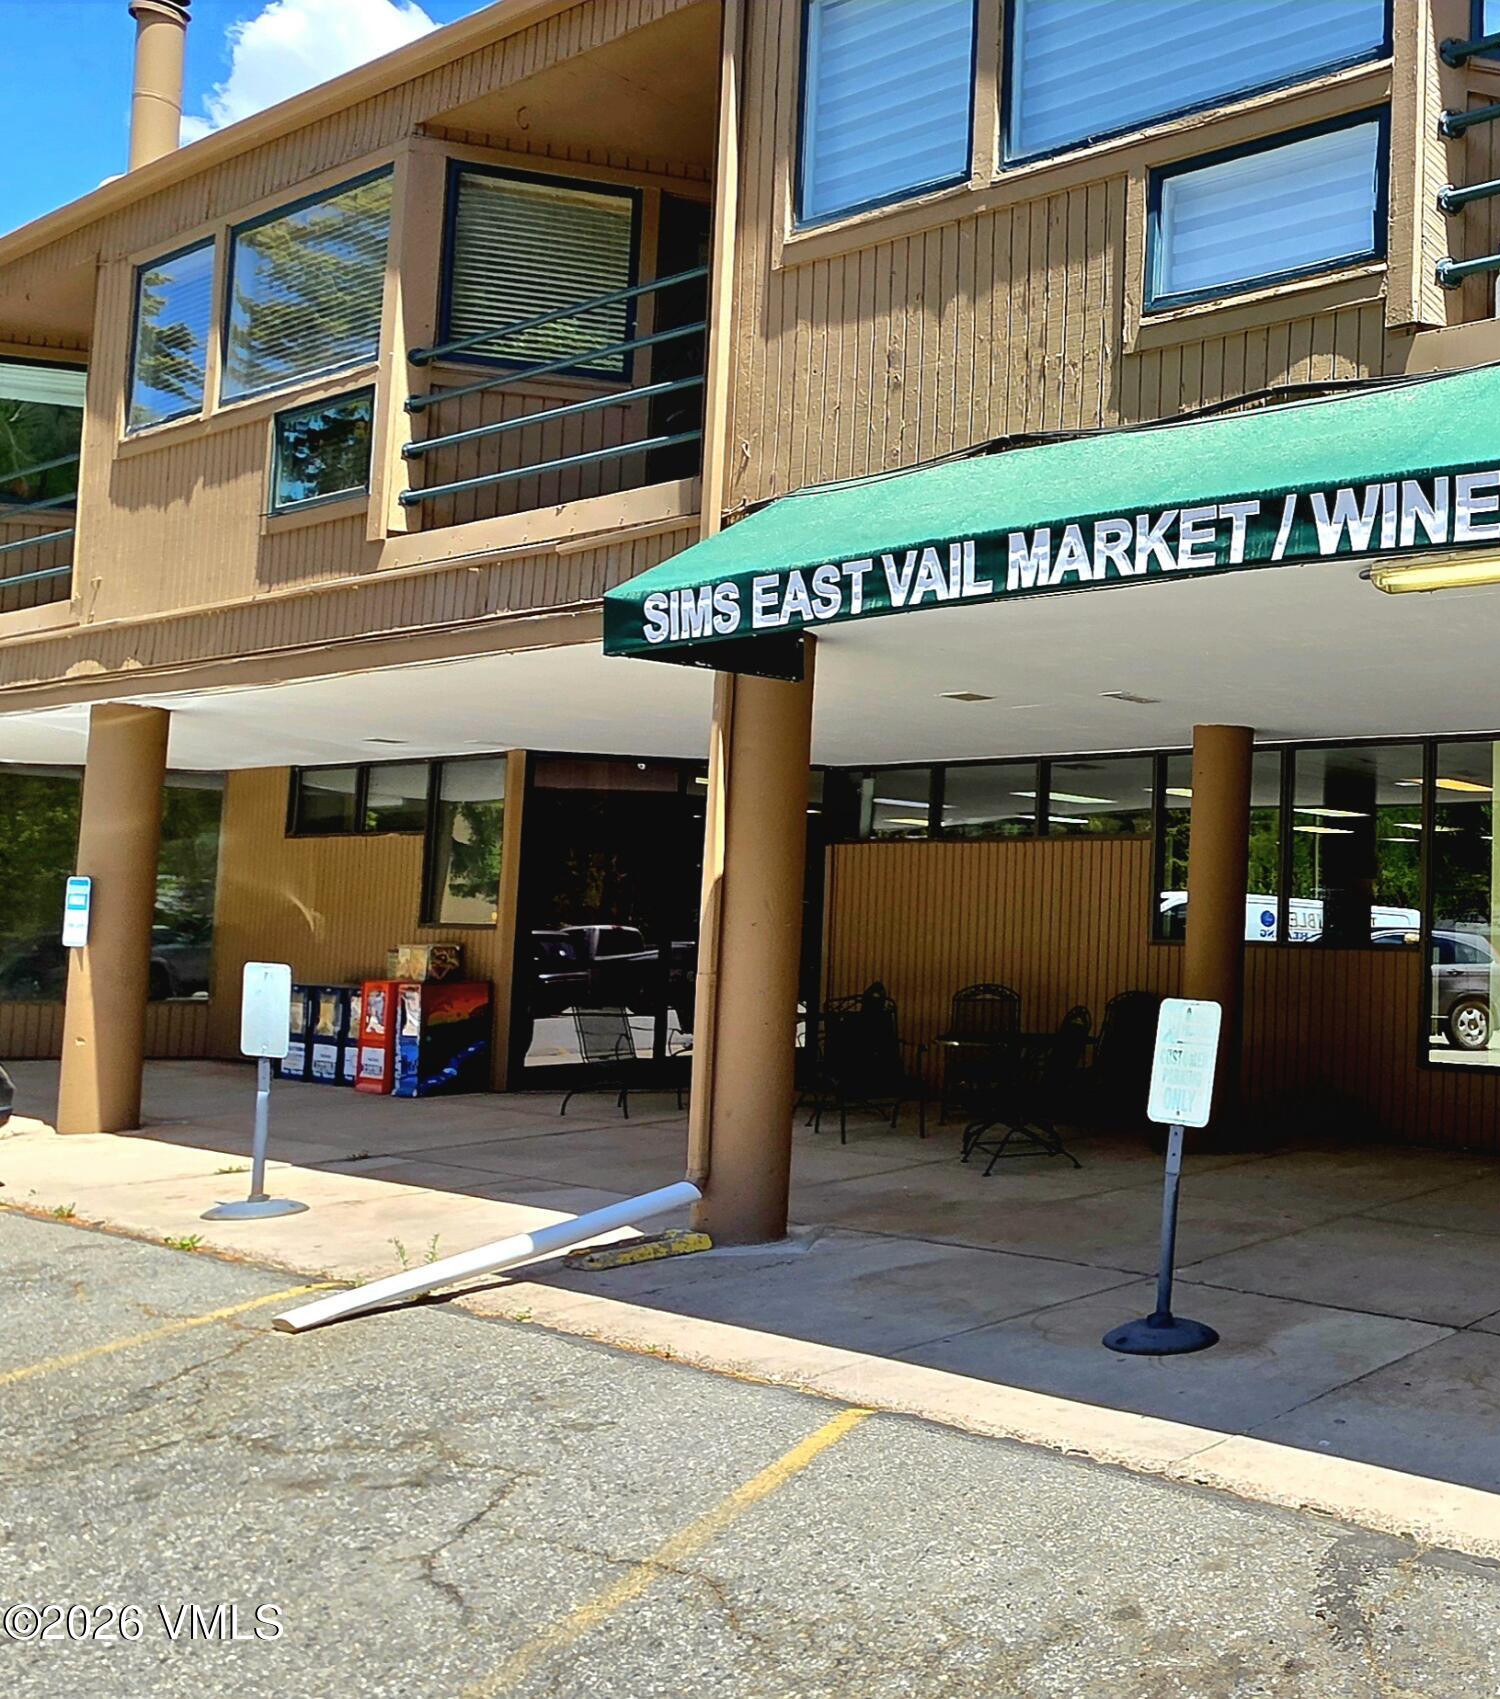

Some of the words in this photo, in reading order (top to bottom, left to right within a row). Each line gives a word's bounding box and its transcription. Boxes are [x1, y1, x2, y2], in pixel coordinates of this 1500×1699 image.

[643, 581, 740, 645] SIMS
[751, 557, 873, 630] EAST
[880, 537, 994, 608] VAIL
[1006, 500, 1262, 593] MARKET
